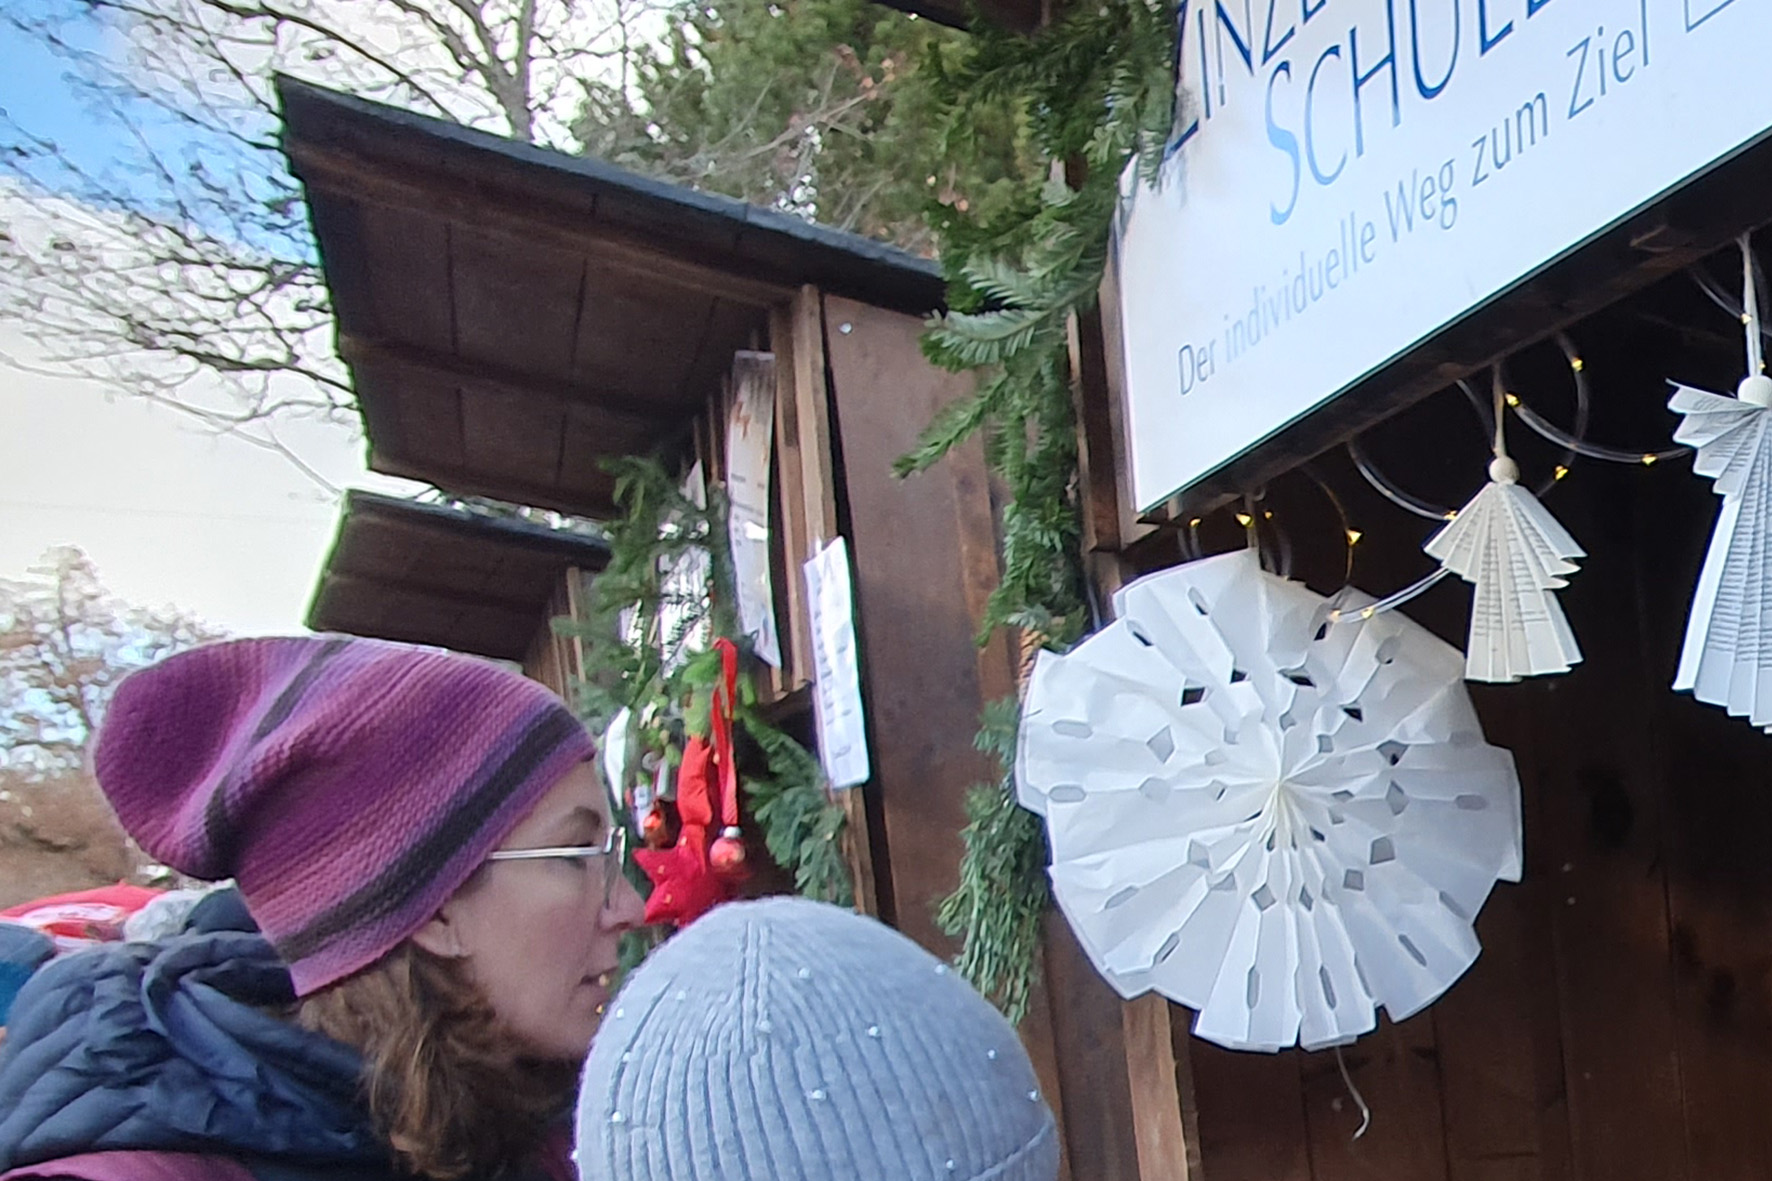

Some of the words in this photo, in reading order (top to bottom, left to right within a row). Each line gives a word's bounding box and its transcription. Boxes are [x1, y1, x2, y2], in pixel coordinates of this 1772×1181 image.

[1179, 338, 1216, 396] Der
[1224, 210, 1377, 364] individuelle
[1384, 158, 1457, 243] Weg
[1471, 91, 1548, 187] zum
[1566, 0, 1649, 120] Ziel
[1265, 0, 1551, 226] SCHUL
